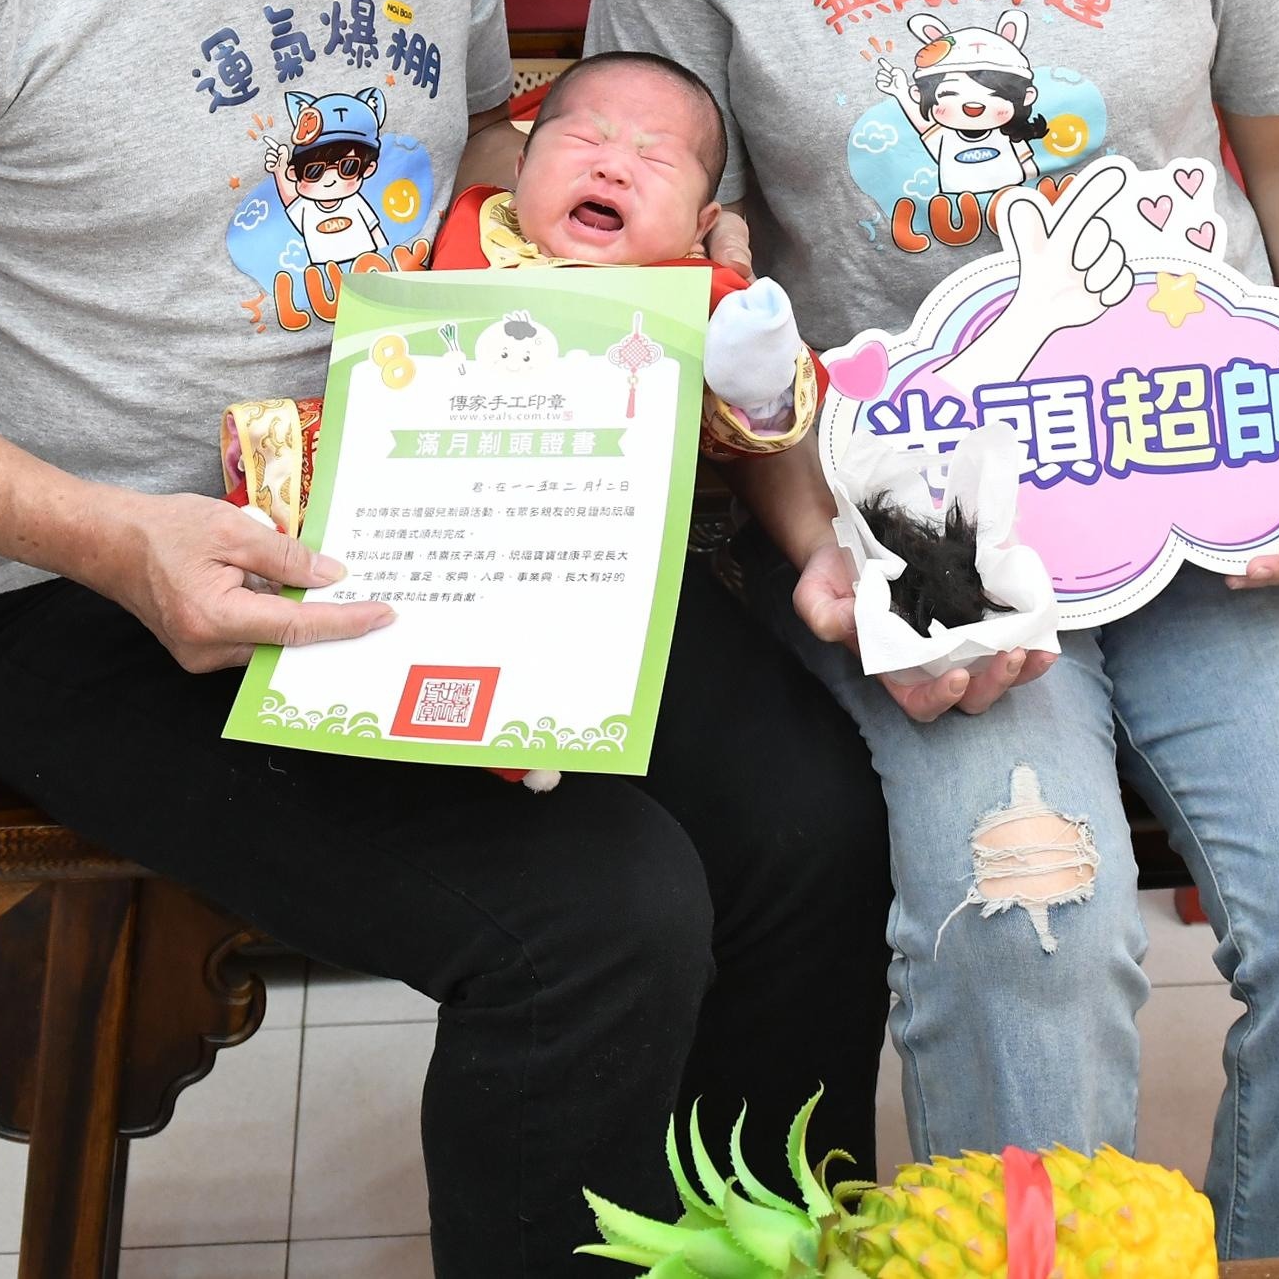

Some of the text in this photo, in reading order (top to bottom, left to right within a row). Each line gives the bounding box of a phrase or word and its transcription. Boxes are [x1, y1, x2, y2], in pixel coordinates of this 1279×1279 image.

[332, 107, 348, 122] T
[962, 149, 993, 161] MOM
[324, 219, 345, 231] DAD
[449, 394, 566, 411] 傳家手工印章
[449, 411, 561, 421] www.seals.com.tw
[416, 431, 596, 456] 滿月剃頭證書
